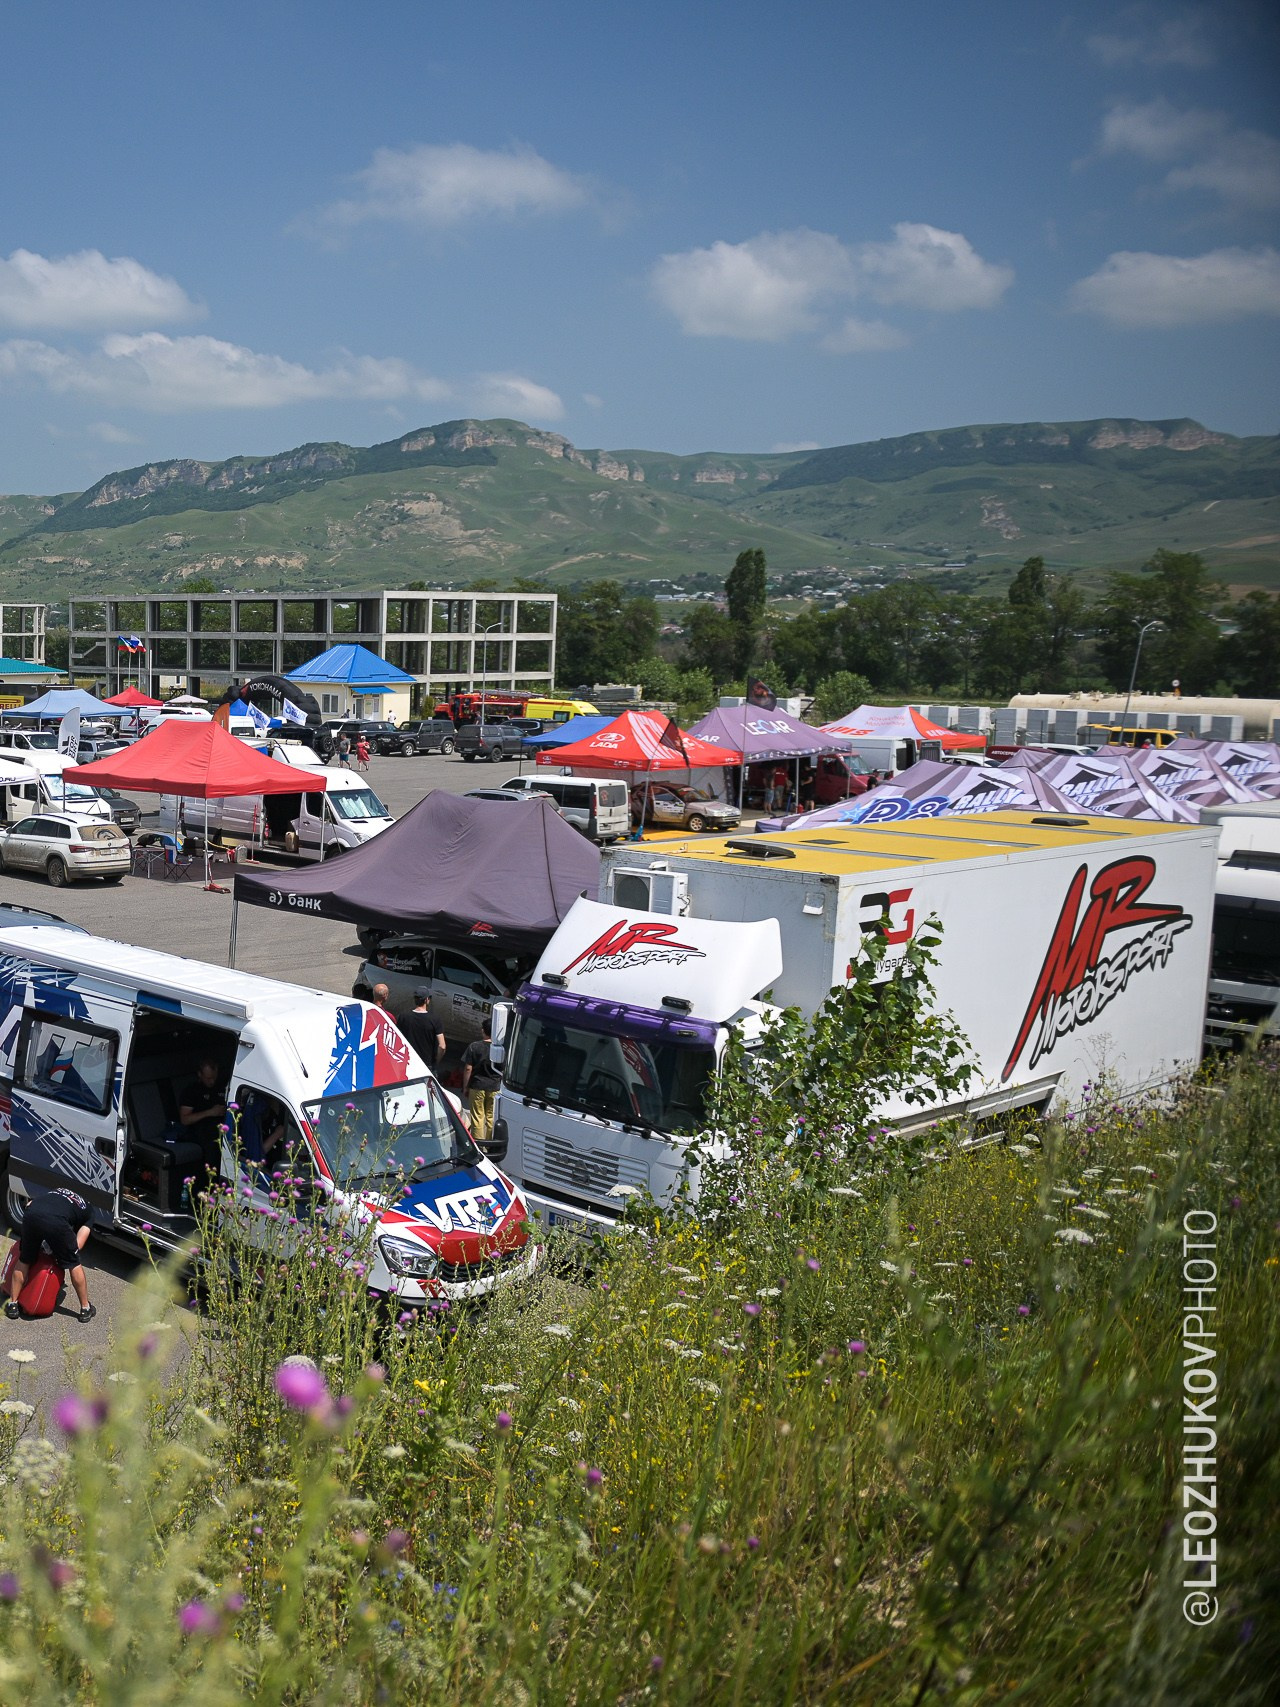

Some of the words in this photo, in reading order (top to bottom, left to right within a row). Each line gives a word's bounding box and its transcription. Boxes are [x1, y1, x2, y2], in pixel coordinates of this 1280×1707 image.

[249, 682, 282, 698] YOKOHAMA
[740, 720, 796, 736] LECAR
[589, 741, 618, 749] LADA
[954, 787, 1025, 810] RALLY
[287, 893, 322, 911] банк
[561, 919, 699, 975] MR
[1001, 855, 1184, 1083] MR
[413, 1184, 507, 1233] VRT
